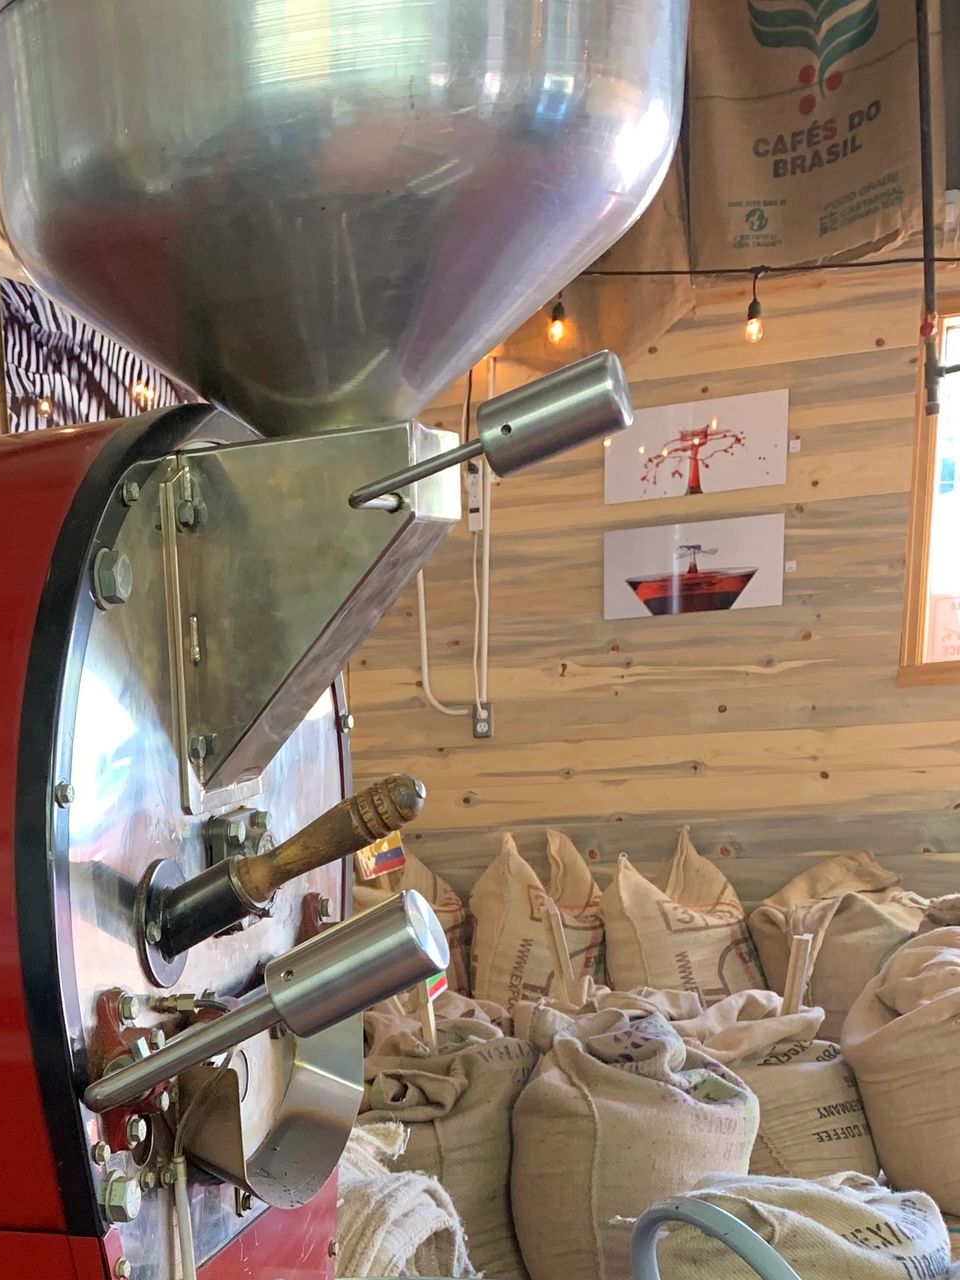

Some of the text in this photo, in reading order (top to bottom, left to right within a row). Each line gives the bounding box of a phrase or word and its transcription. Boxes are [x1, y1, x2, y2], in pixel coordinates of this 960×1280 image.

[752, 100, 882, 158] CAFÉS DO
[772, 135, 864, 178] BRASIL
[812, 1124, 863, 1144] COFFEE
